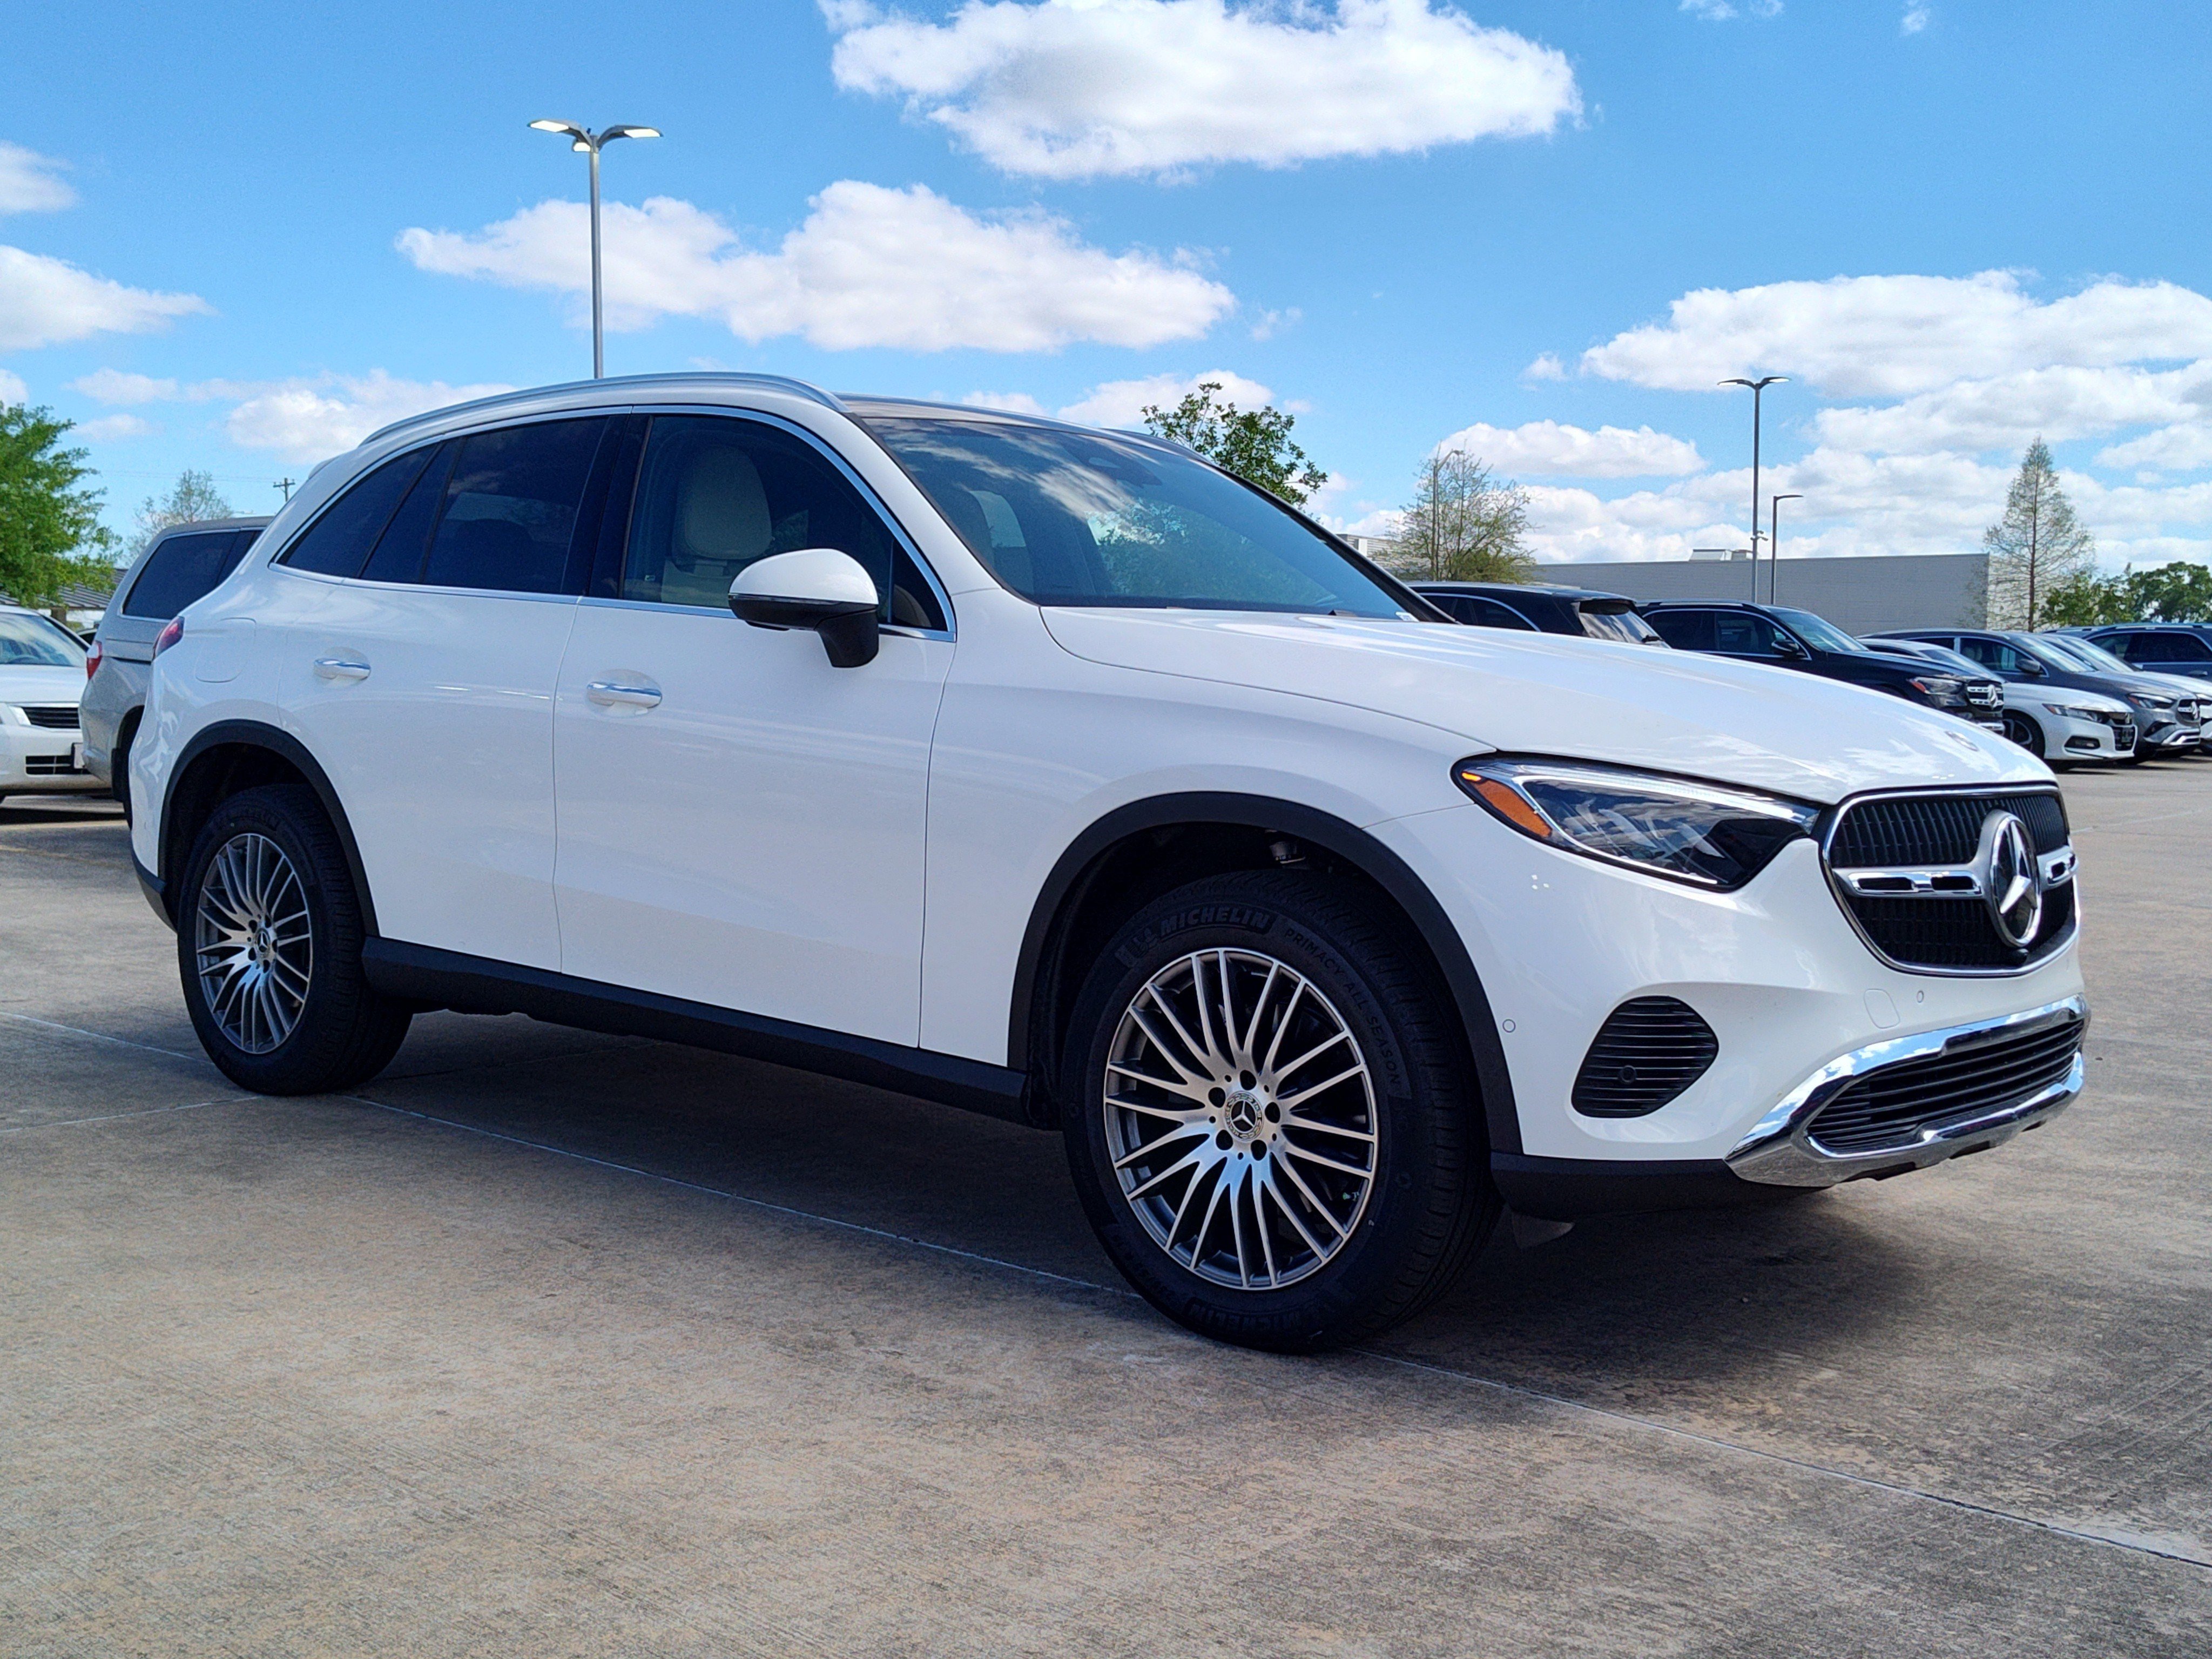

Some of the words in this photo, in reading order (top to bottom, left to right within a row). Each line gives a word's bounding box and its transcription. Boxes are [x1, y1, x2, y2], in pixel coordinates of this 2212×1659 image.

[1159, 906, 1270, 936] MICHELIN
[1284, 927, 1344, 976] PRIMACY
[1344, 982, 1368, 1010] ALL
[1367, 1016, 1401, 1084] SEASON
